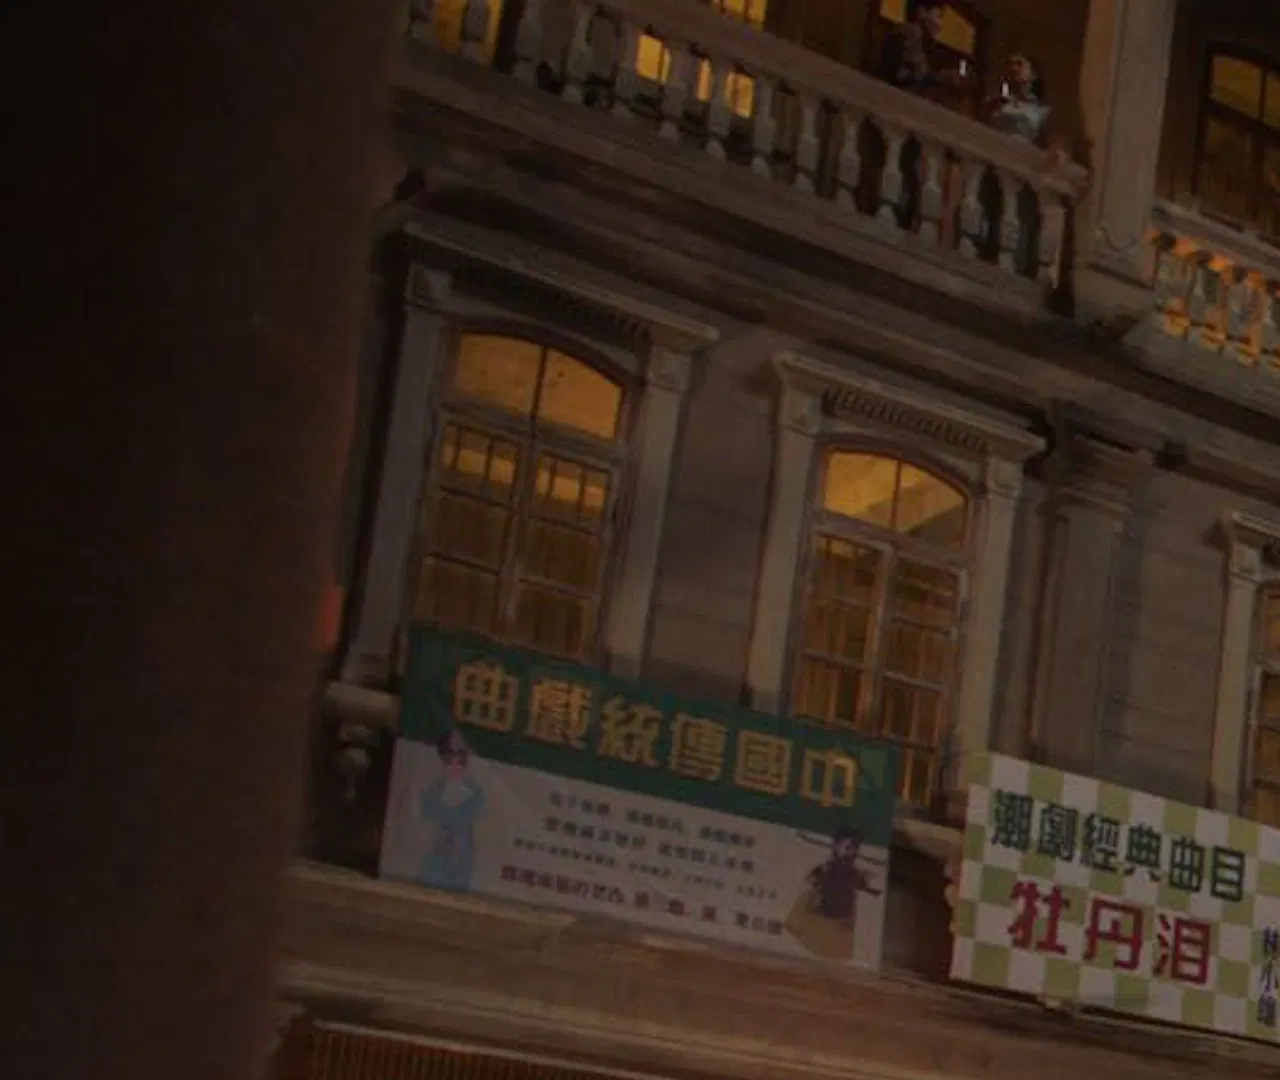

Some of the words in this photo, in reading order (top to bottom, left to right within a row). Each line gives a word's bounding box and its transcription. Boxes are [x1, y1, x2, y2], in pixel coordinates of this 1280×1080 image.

[991, 788, 1246, 902] 潮劇經典曲目
[1007, 880, 1211, 985] 牡丹泪
